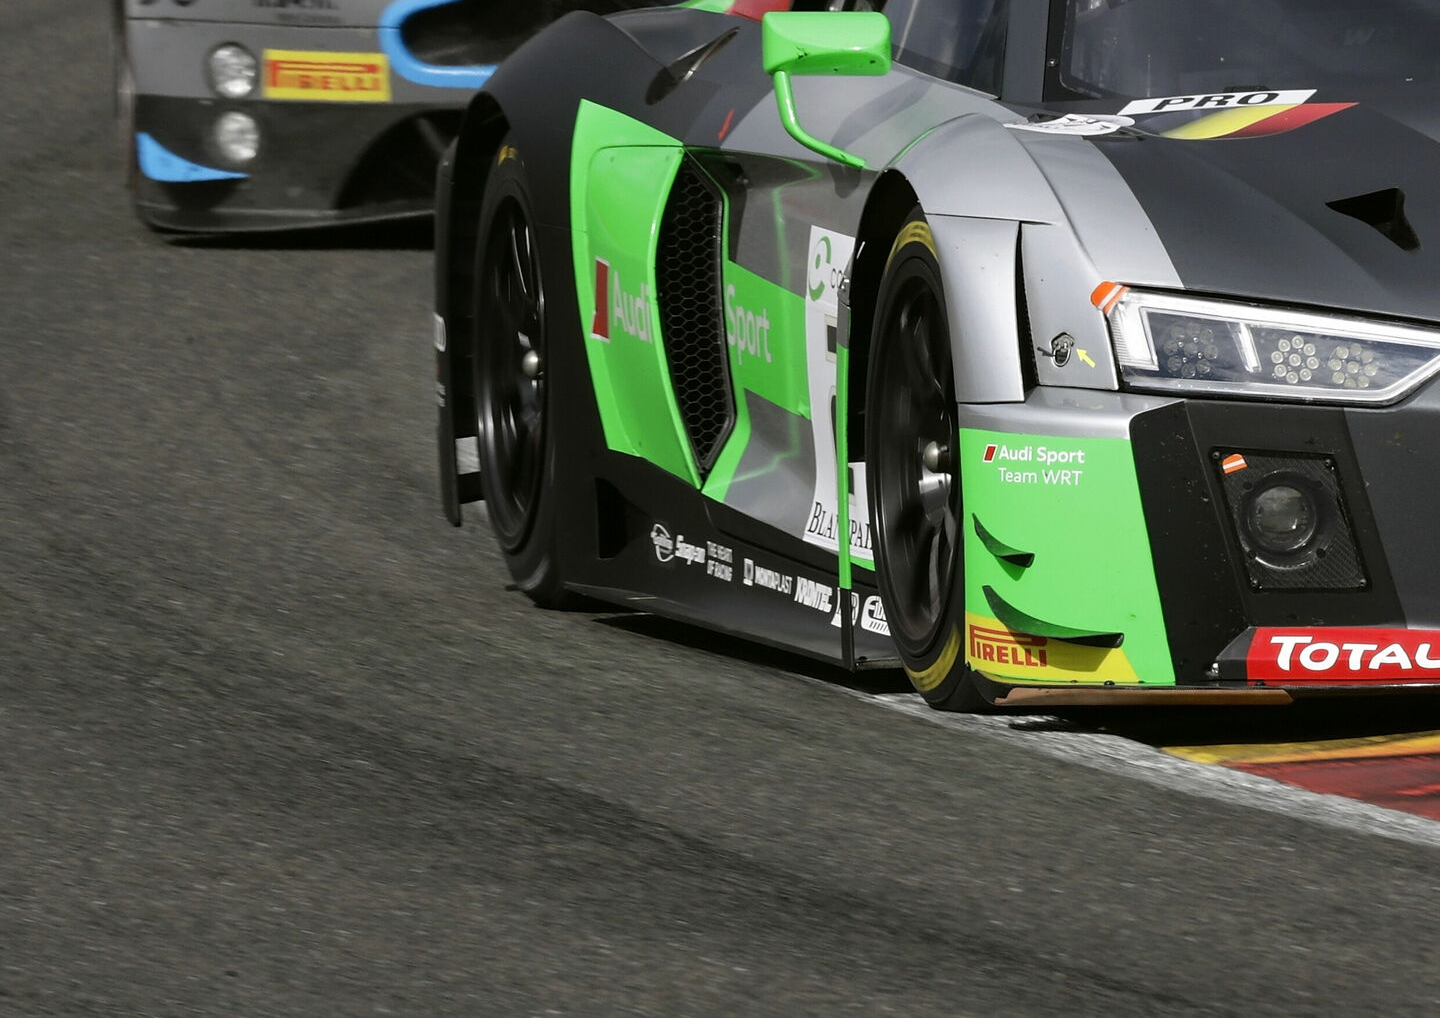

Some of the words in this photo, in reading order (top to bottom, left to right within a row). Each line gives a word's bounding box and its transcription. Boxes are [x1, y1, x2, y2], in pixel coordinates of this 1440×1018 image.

[265, 59, 383, 91] PIRELLI
[1151, 92, 1280, 111] PRO
[613, 271, 653, 344] Audi
[727, 283, 772, 366] Sport
[999, 445, 1033, 462] Audi
[1036, 446, 1086, 465] Sport
[998, 467, 1038, 484] Team
[1042, 469, 1083, 486] WRT
[807, 501, 873, 550] BLAPAI
[969, 624, 1048, 668] PIRELLI
